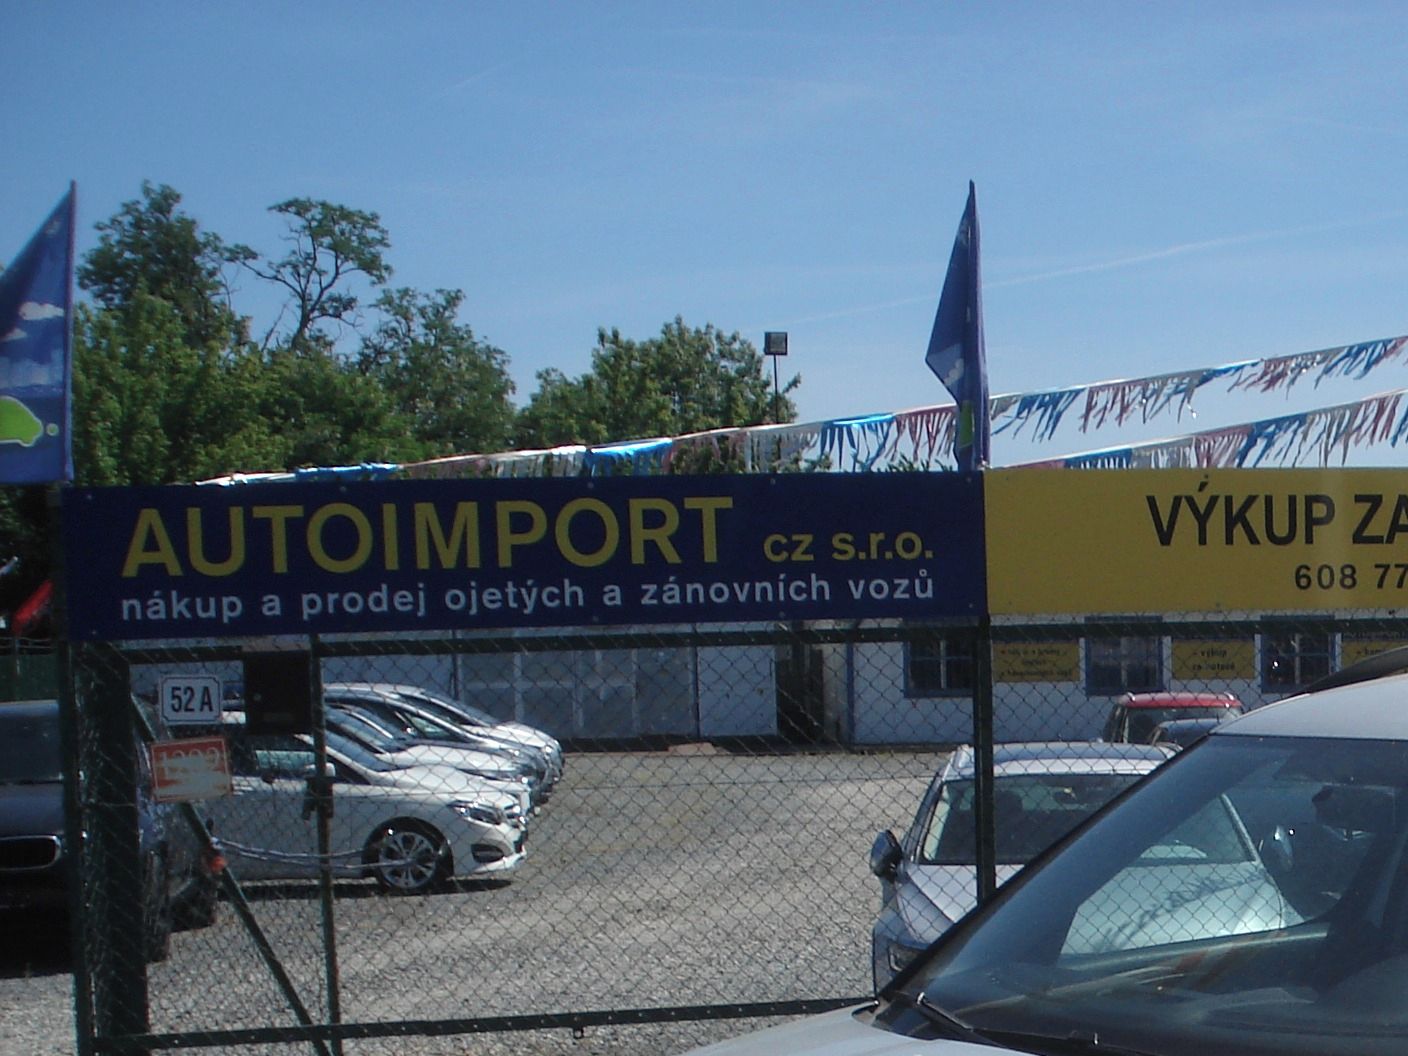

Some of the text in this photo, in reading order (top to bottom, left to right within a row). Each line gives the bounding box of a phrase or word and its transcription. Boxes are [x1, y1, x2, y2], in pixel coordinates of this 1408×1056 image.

[121, 496, 934, 578] AUTOIMPORT cz s.r.o.
[1146, 481, 1335, 547] VÝKUP
[121, 568, 934, 623] nákup a prodej ojetých a zánovních vozů
[1294, 564, 1357, 590] 608
[170, 685, 214, 713] 52 A
